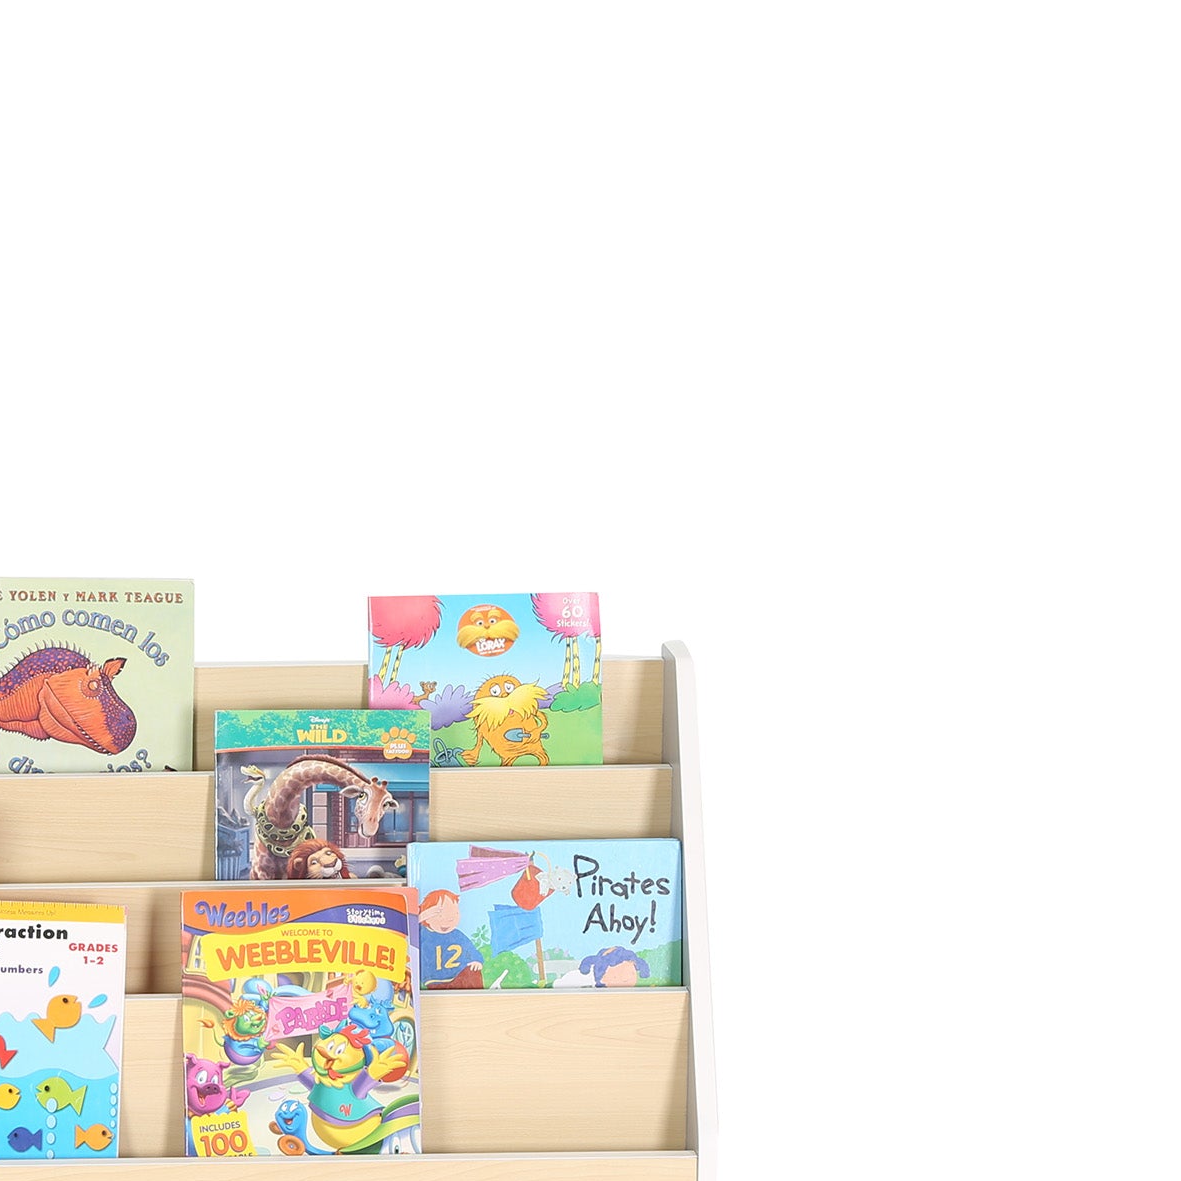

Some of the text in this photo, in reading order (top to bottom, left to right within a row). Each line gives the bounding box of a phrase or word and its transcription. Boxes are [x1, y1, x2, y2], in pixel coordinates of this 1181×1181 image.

[9, 590, 56, 602] YOLEN
[76, 591, 119, 603] MARK
[124, 592, 184, 604] TEAGUE
[562, 605, 583, 619] 60
[556, 618, 590, 628] Stickers!
[62, 609, 141, 643] comen
[137, 631, 170, 667] los
[296, 729, 348, 743] WILD
[573, 854, 670, 900] Pirates
[195, 901, 290, 928] Weebles
[346, 907, 385, 918] Storytime
[582, 900, 657, 944] Ahoy!
[281, 928, 333, 937] WELCOME TO
[68, 942, 119, 953] GRADES
[83, 956, 104, 965] 1-2
[216, 939, 396, 972] WEEBLEVILLE!
[435, 944, 463, 971] 12
[276, 997, 348, 1035] PARADE
[339, 1104, 352, 1117] W
[200, 1121, 241, 1133] INCLUDES
[200, 1130, 248, 1157] 100
